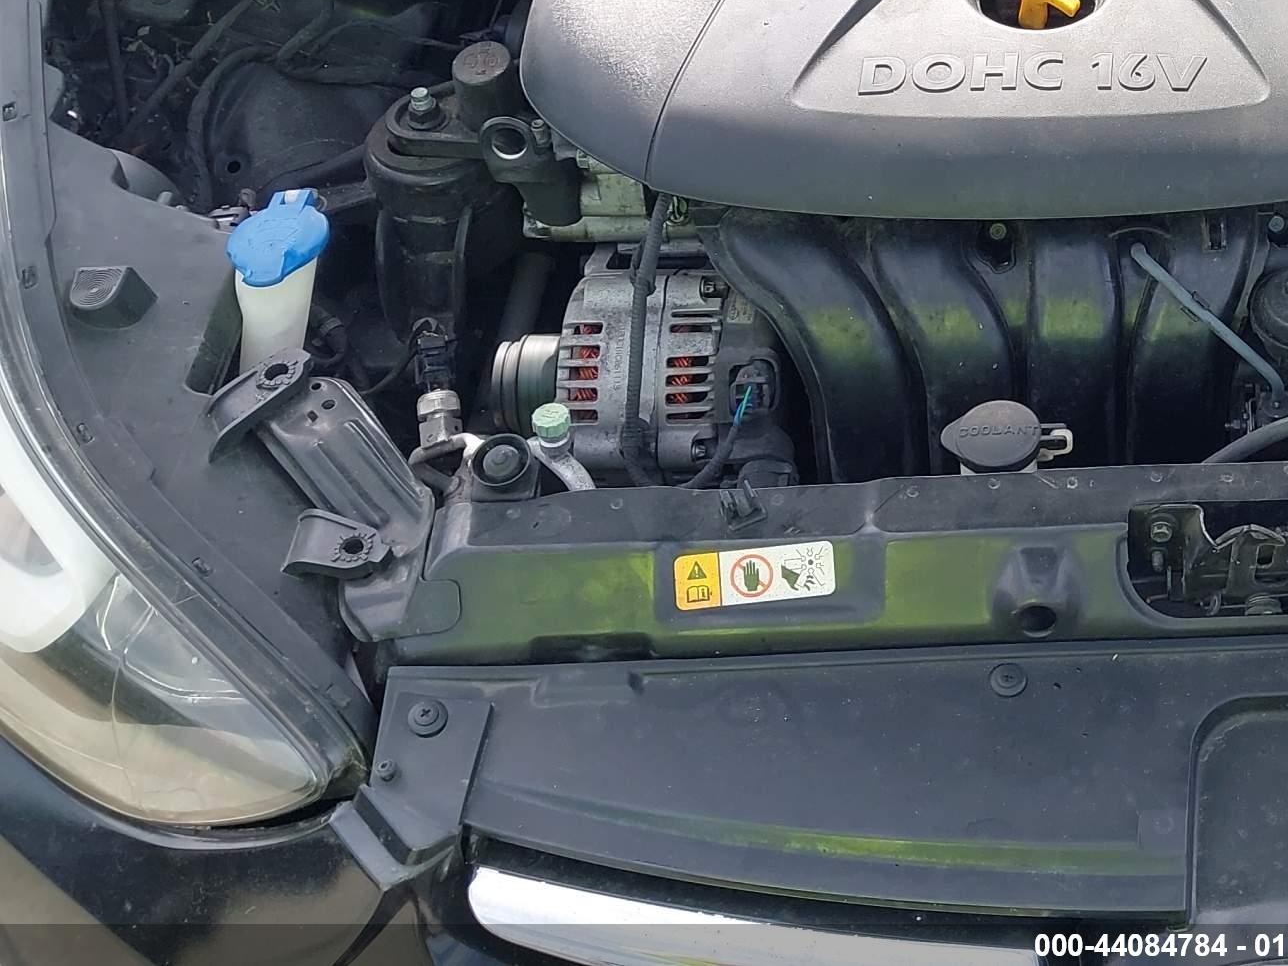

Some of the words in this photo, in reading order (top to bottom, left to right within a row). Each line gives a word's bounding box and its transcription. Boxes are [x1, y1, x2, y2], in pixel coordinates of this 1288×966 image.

[858, 52, 1064, 96] DOHC
[1092, 52, 1208, 92] 16V
[959, 425, 1041, 438] COOLANT
